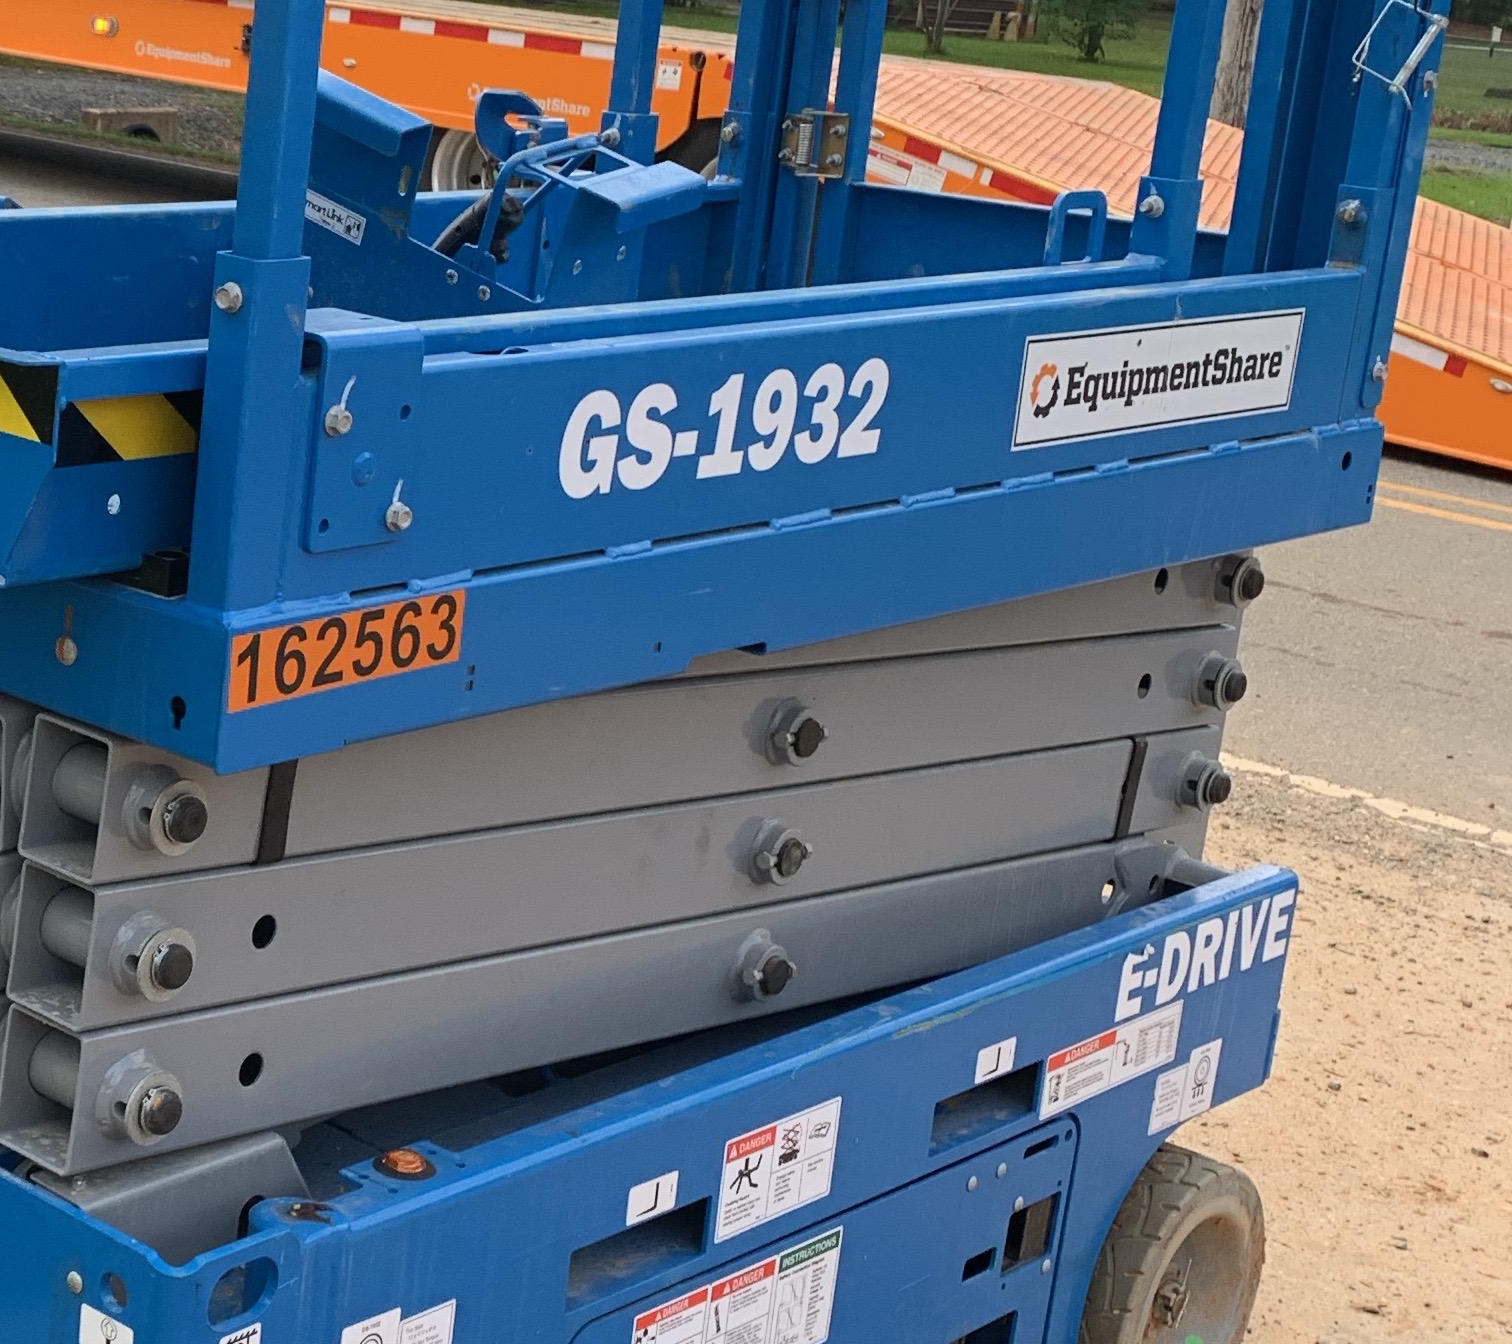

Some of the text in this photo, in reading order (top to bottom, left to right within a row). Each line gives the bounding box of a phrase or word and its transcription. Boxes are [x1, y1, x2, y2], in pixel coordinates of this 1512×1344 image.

[1065, 347, 1283, 413] EquipmentShare
[559, 357, 889, 499] GS-1932
[236, 594, 458, 704] 162563
[1114, 888, 1296, 1023] E-DRIVE
[1070, 1038, 1101, 1062] DANGER
[738, 1131, 773, 1154] DANGER
[781, 1235, 838, 1270] INSTRUCTIONS
[731, 1266, 765, 1290] DANGER
[662, 1298, 690, 1321] DANGER
